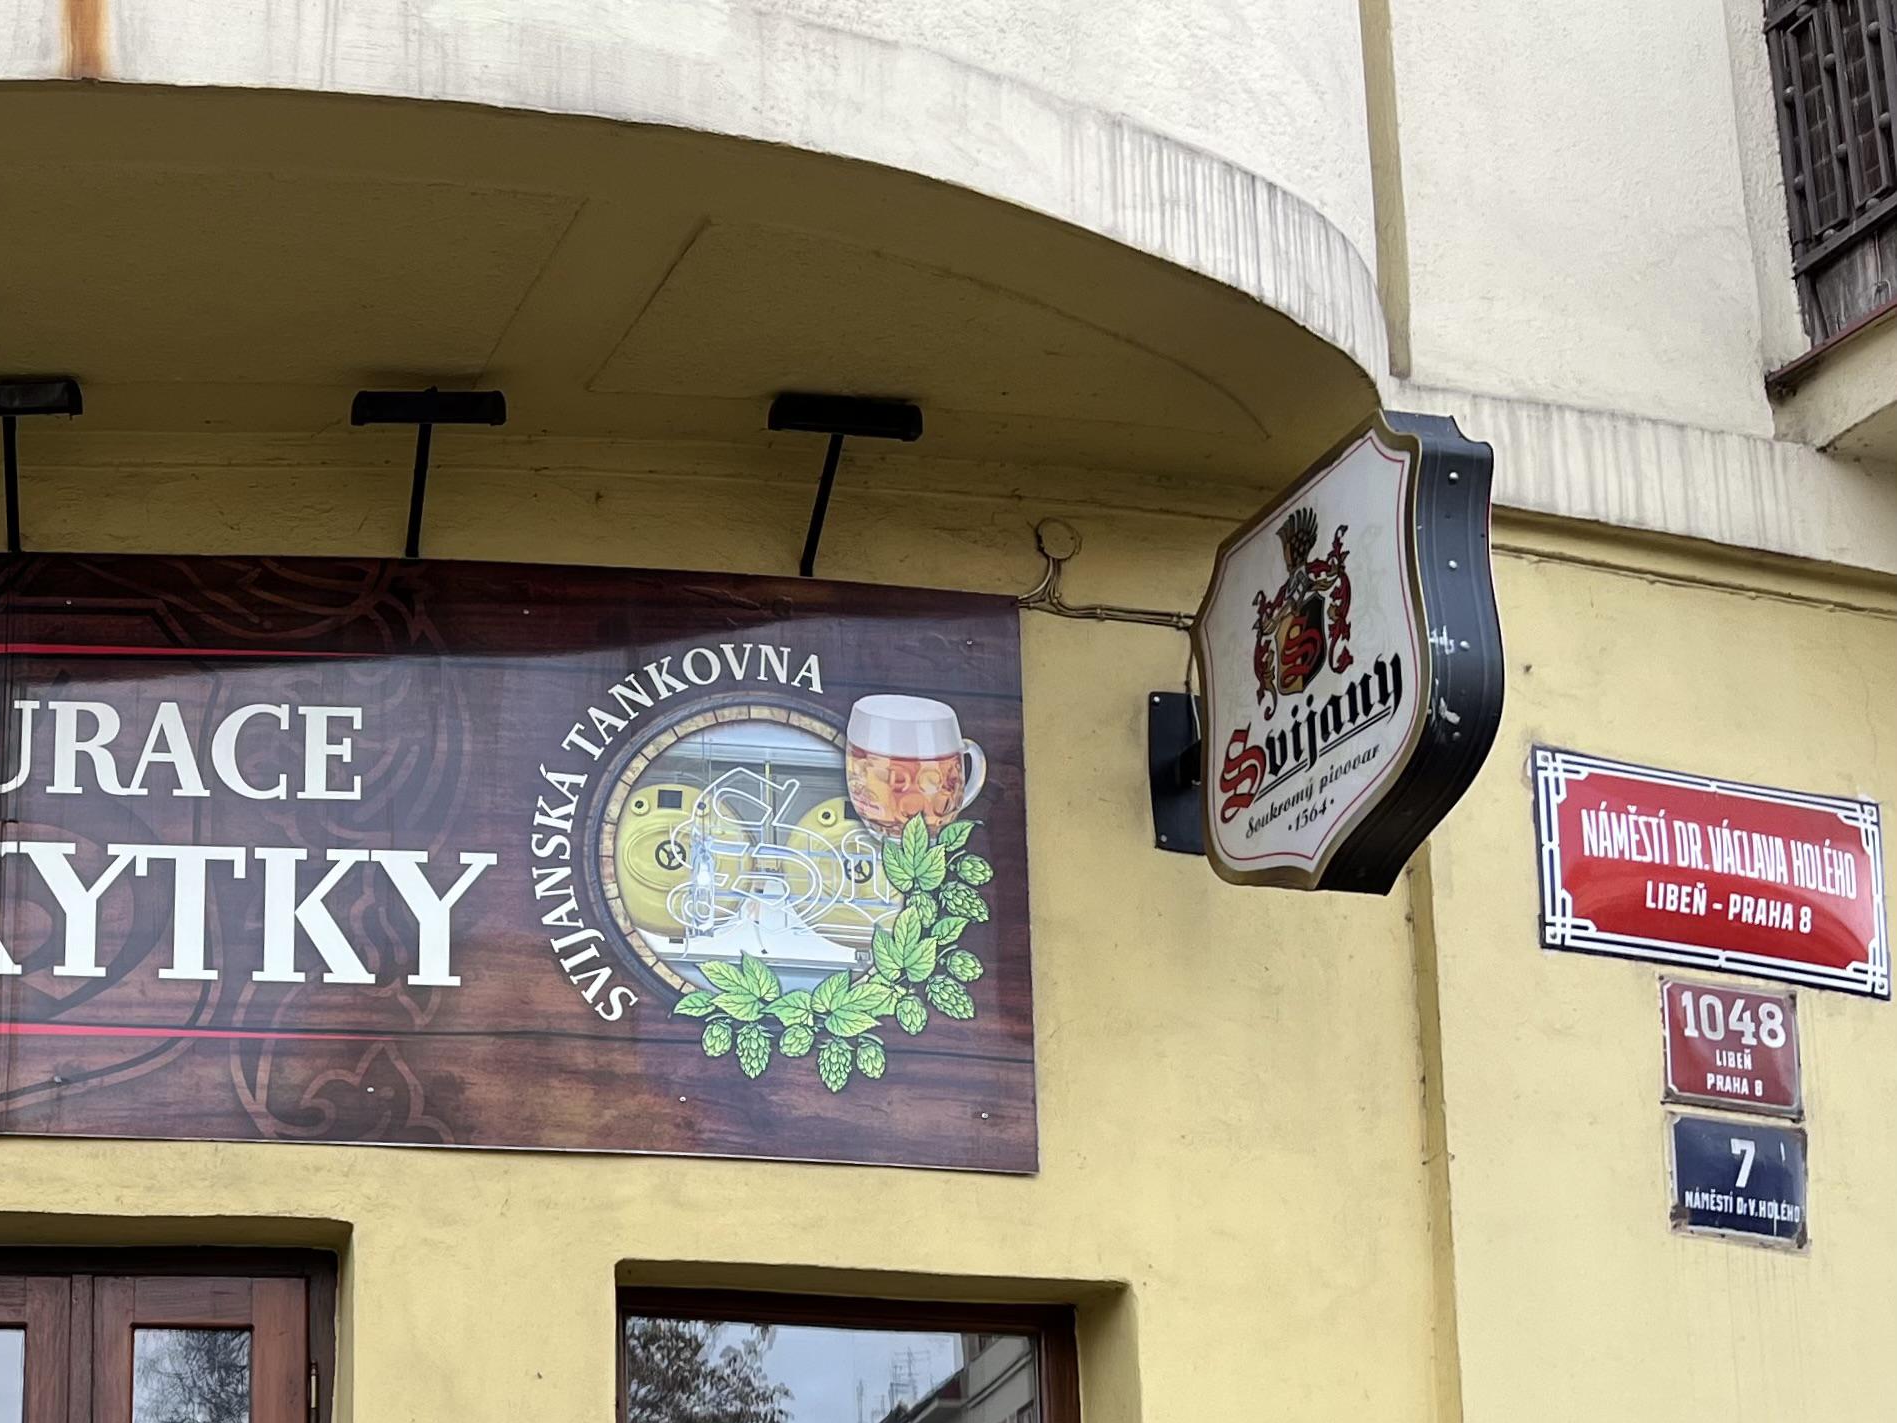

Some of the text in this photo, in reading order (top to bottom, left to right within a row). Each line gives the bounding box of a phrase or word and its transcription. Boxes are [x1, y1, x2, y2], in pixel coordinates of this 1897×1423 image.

[561, 643, 824, 761] TANKOVNA
[1220, 652, 1403, 824] Svijany
[1245, 743, 1381, 839] Soukromý pivovar
[1580, 801, 1670, 866] NÁMĚSTÍ
[1707, 818, 1789, 885] VÁCLAVA
[1791, 838, 1857, 900] HOLÉHO
[532, 763, 638, 1022] SVIJANSKÁ
[1646, 880, 1707, 917] LIBEŇ
[1728, 893, 1794, 932] PRAHA
[1799, 907, 1812, 934] 8
[1681, 990, 1786, 1049] 1048
[1706, 1072, 1749, 1095] PRAHA
[1715, 1048, 1753, 1071] LIBEŇ
[1730, 1138, 1755, 1188] 7
[1684, 1187, 1734, 1214] NÁMĚSTÍ
